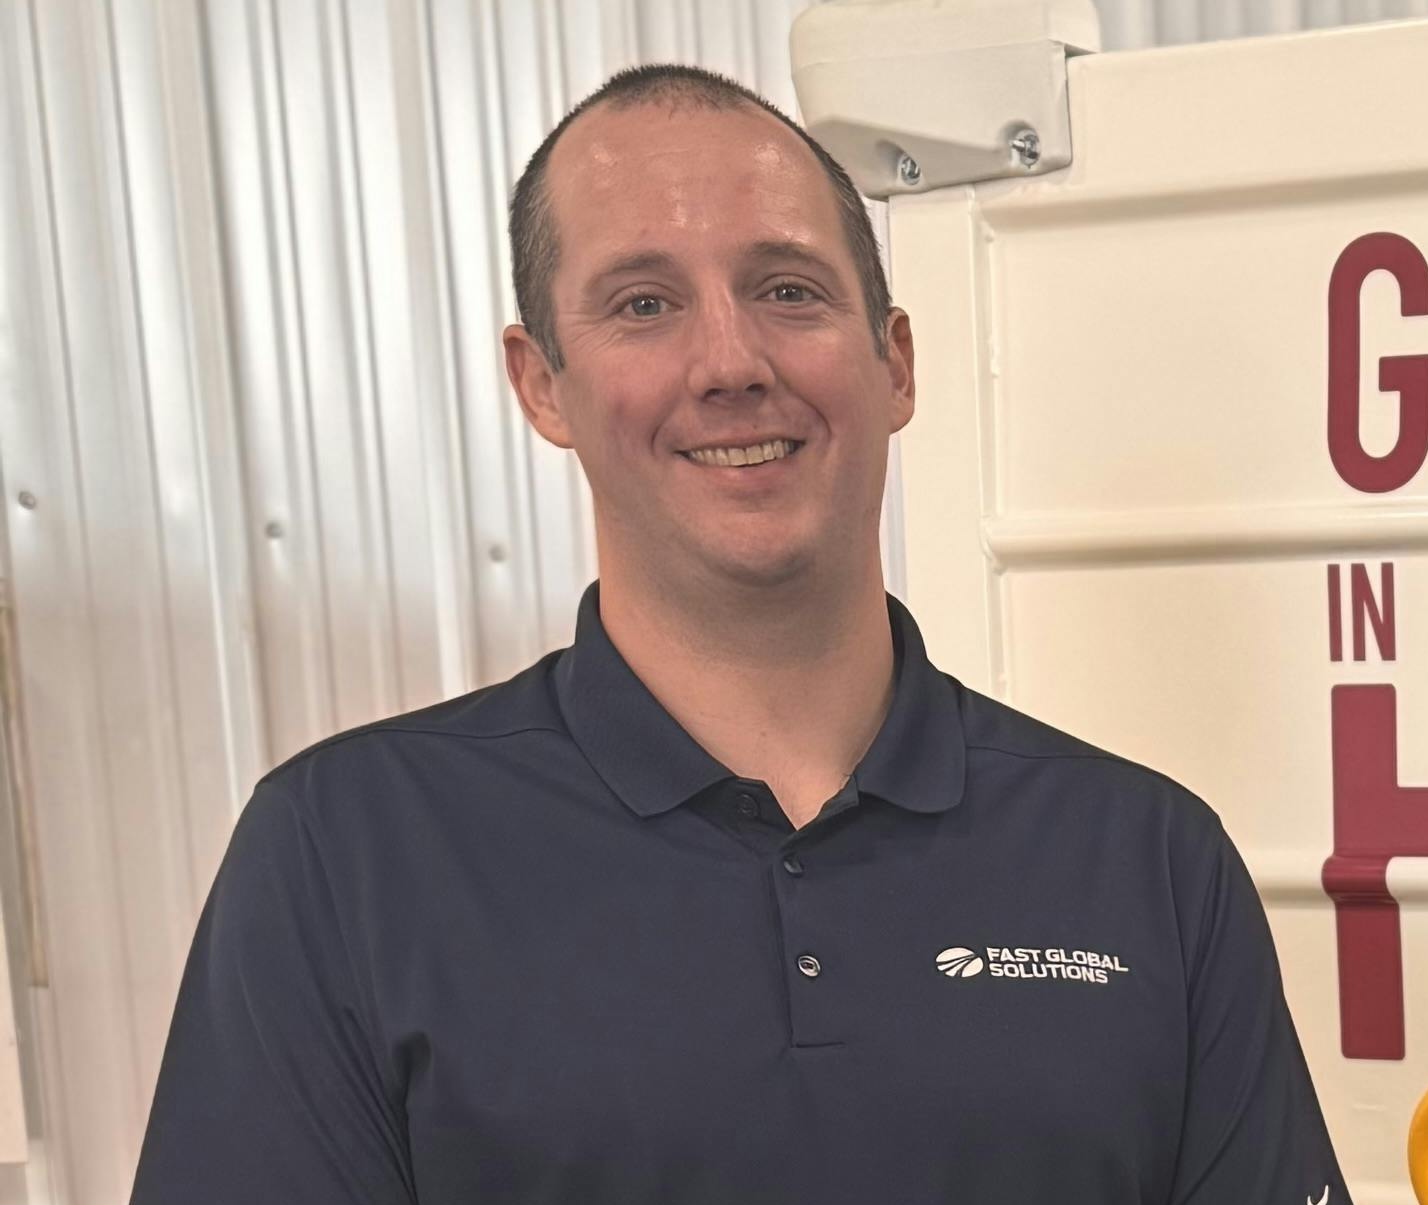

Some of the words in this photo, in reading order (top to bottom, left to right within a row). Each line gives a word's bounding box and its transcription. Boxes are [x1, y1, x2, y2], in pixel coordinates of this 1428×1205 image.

[1327, 562, 1396, 662] IN
[986, 947, 1041, 963] FAST
[1045, 948, 1129, 972] GLOBAL
[989, 963, 1108, 984] SOLUTIONS
